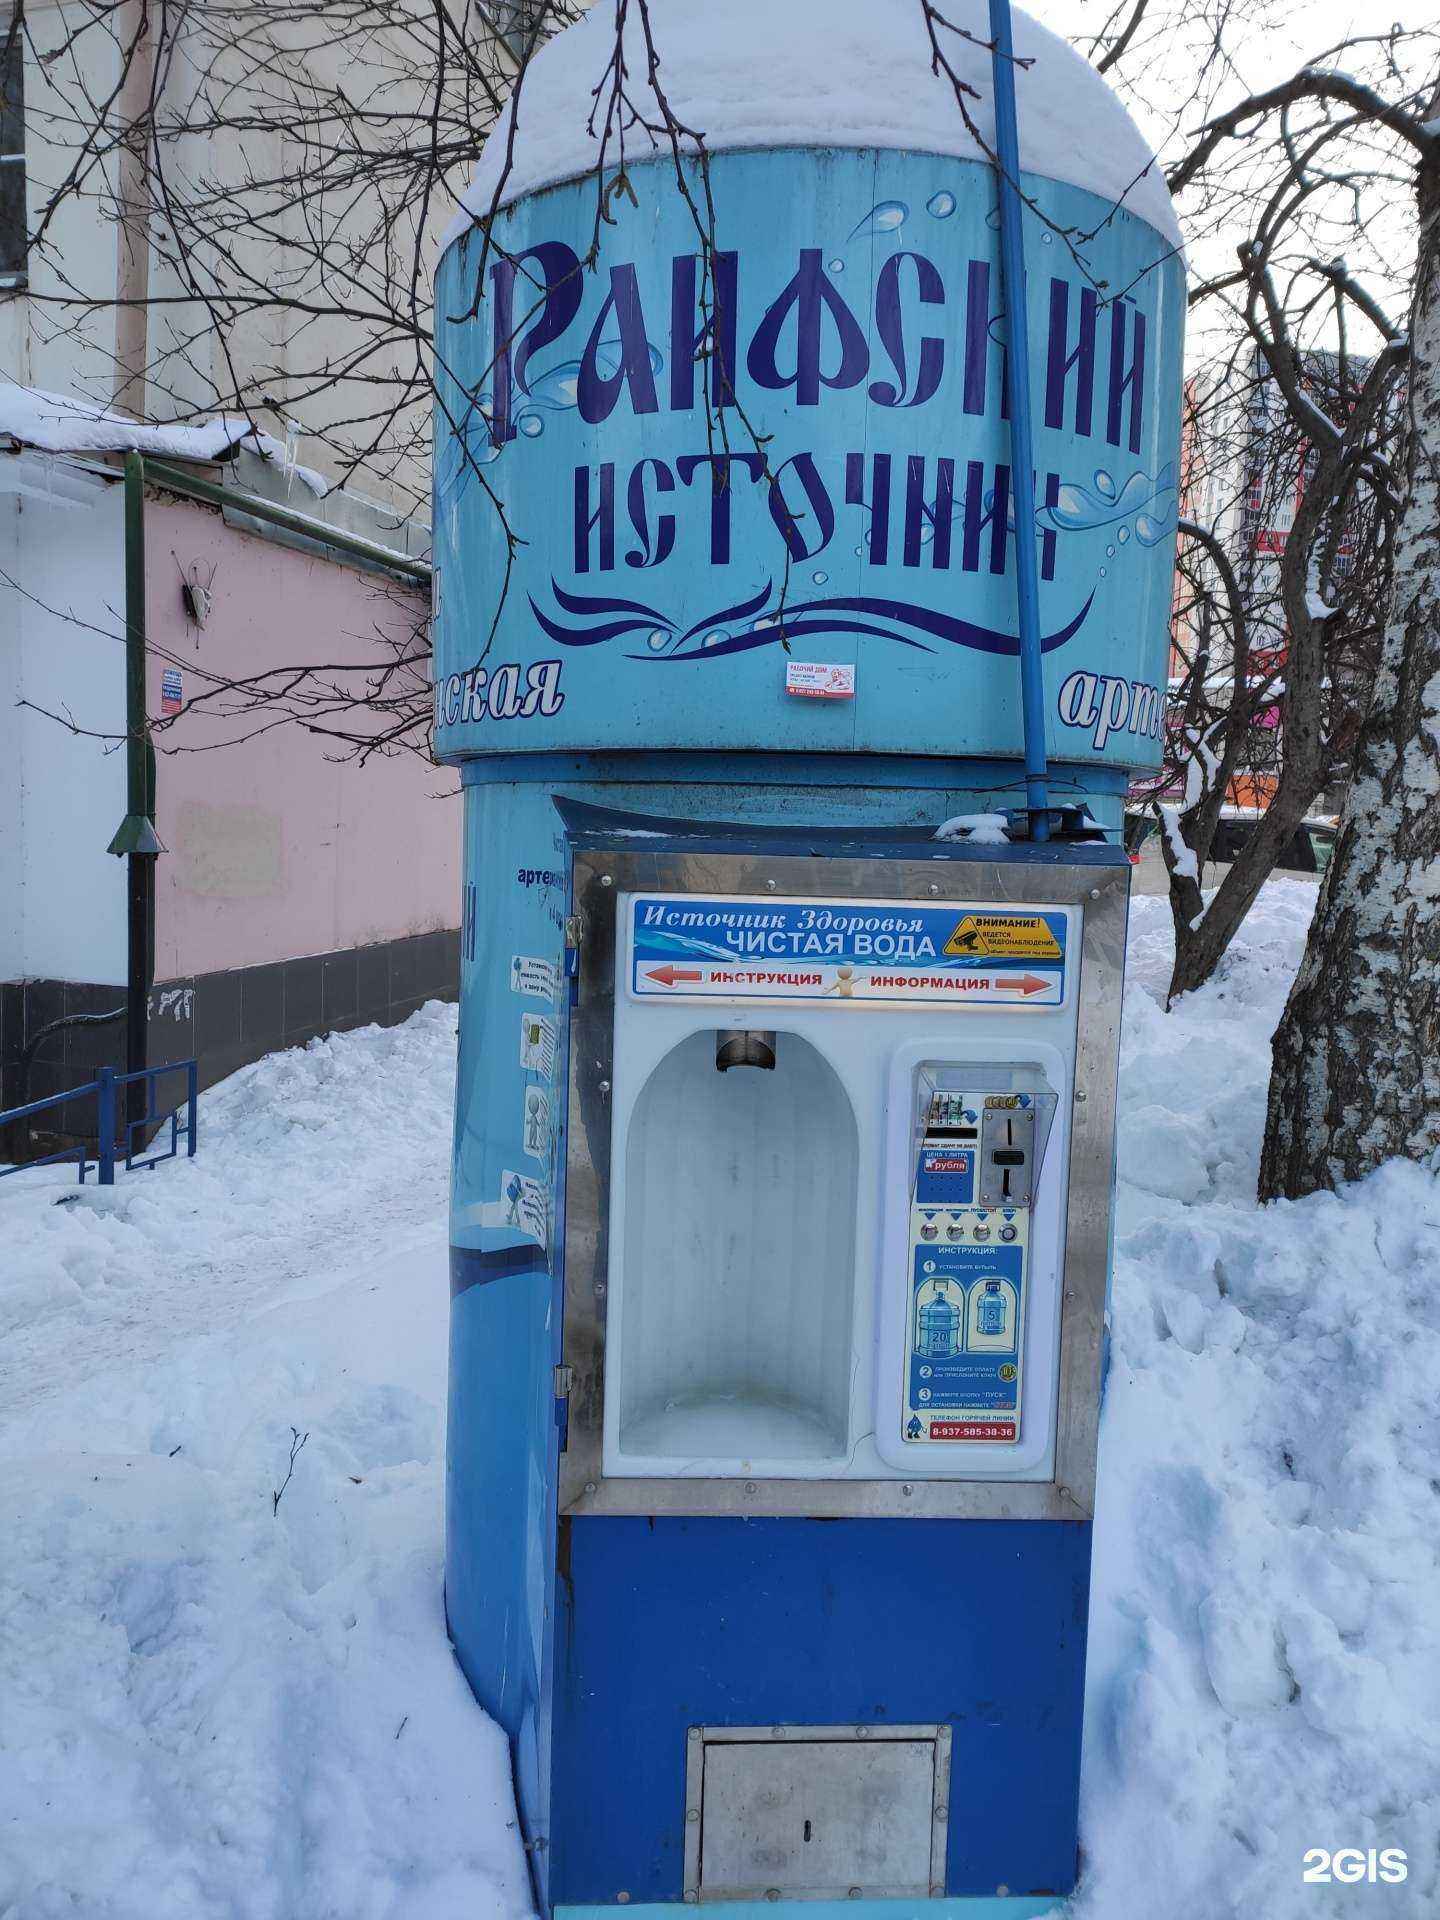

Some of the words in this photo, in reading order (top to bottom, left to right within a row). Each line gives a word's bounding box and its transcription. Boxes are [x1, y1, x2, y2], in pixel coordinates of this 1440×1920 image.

[642, 905, 786, 928] Источник
[798, 910, 923, 935] Здоровья
[975, 918, 1041, 928] ВНИМАНИЕ!
[726, 931, 843, 954] ЧИСТАЯ
[854, 934, 937, 961] ВОДА
[710, 971, 823, 987] ИНСТРУКЦИЯ
[870, 975, 990, 991] ИНФОРМАЦИЯ
[935, 1161, 965, 1170] рубля
[938, 1246, 999, 1256] ИНСТРУКЦИЯ:
[988, 1311, 996, 1321] 5
[932, 1331, 947, 1343] 20
[922, 1367, 930, 1377] 2
[921, 1389, 929, 1398] 3
